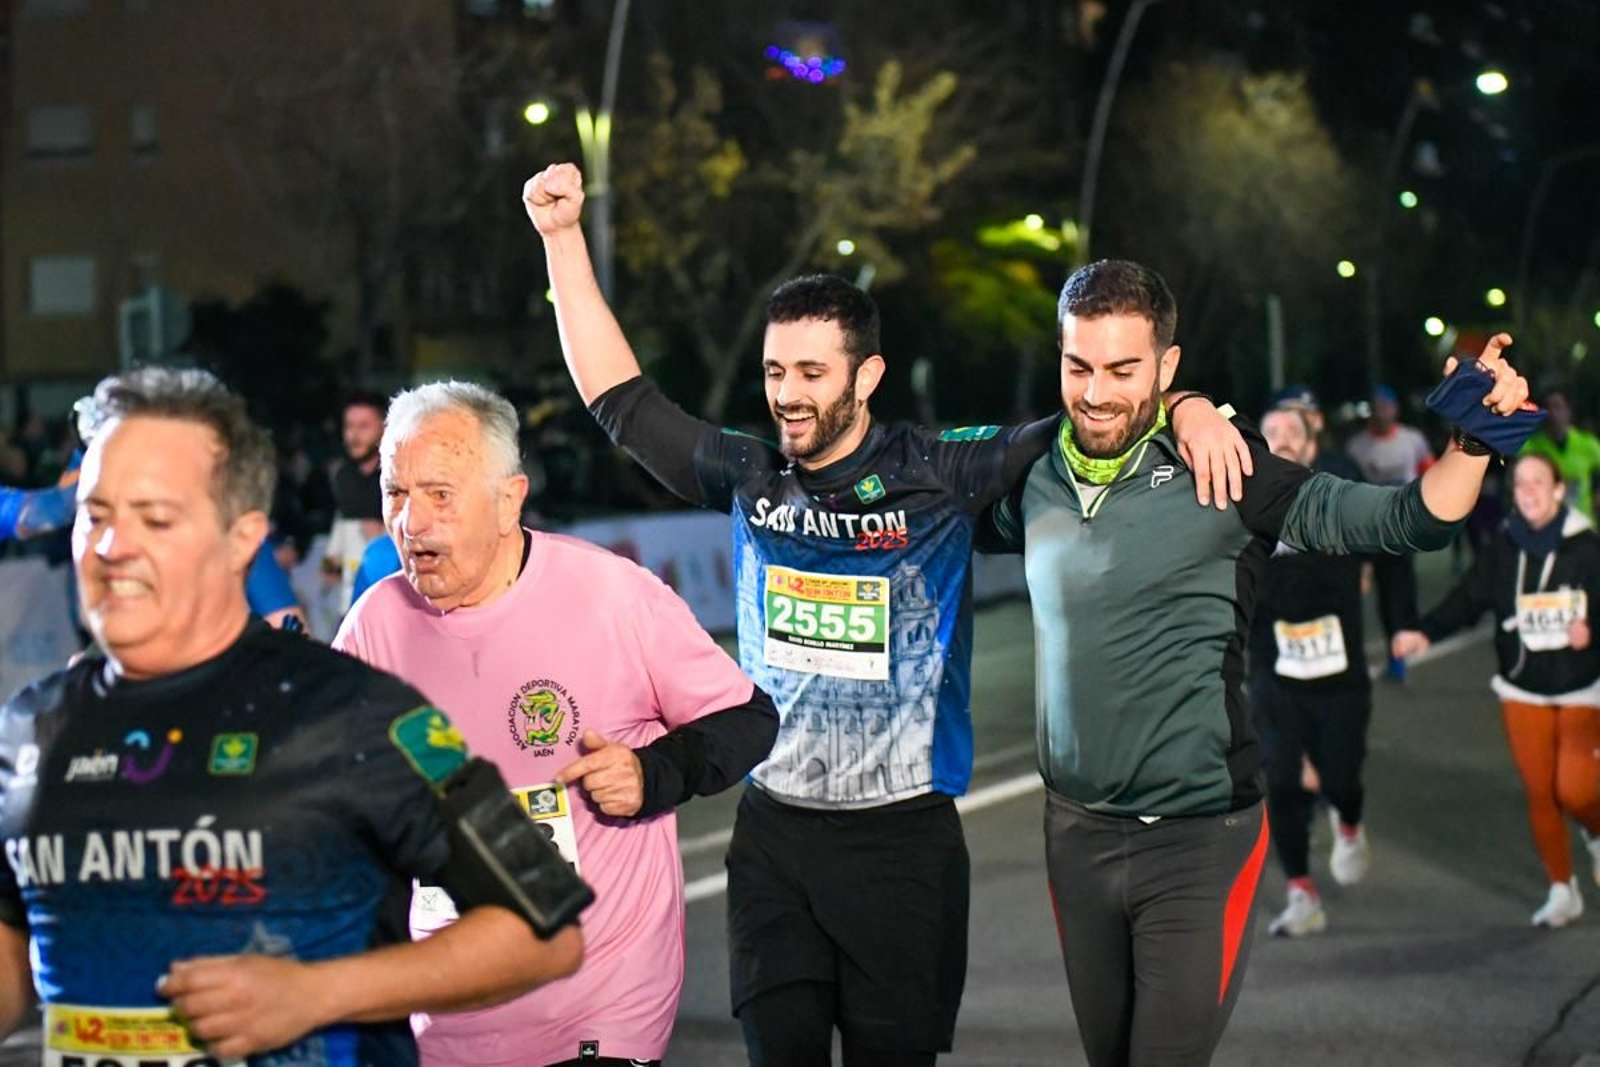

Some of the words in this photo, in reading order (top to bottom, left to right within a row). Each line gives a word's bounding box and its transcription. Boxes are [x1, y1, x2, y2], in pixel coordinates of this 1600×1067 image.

[749, 497, 796, 533] SAN
[854, 527, 909, 551] 2025
[772, 596, 876, 642] 2555
[508, 693, 527, 750] ASOCIACION
[520, 679, 568, 697] DEPORTIVA
[565, 696, 580, 746] MARATON
[78, 814, 264, 882] ANTÓN
[171, 865, 267, 906] 2025
